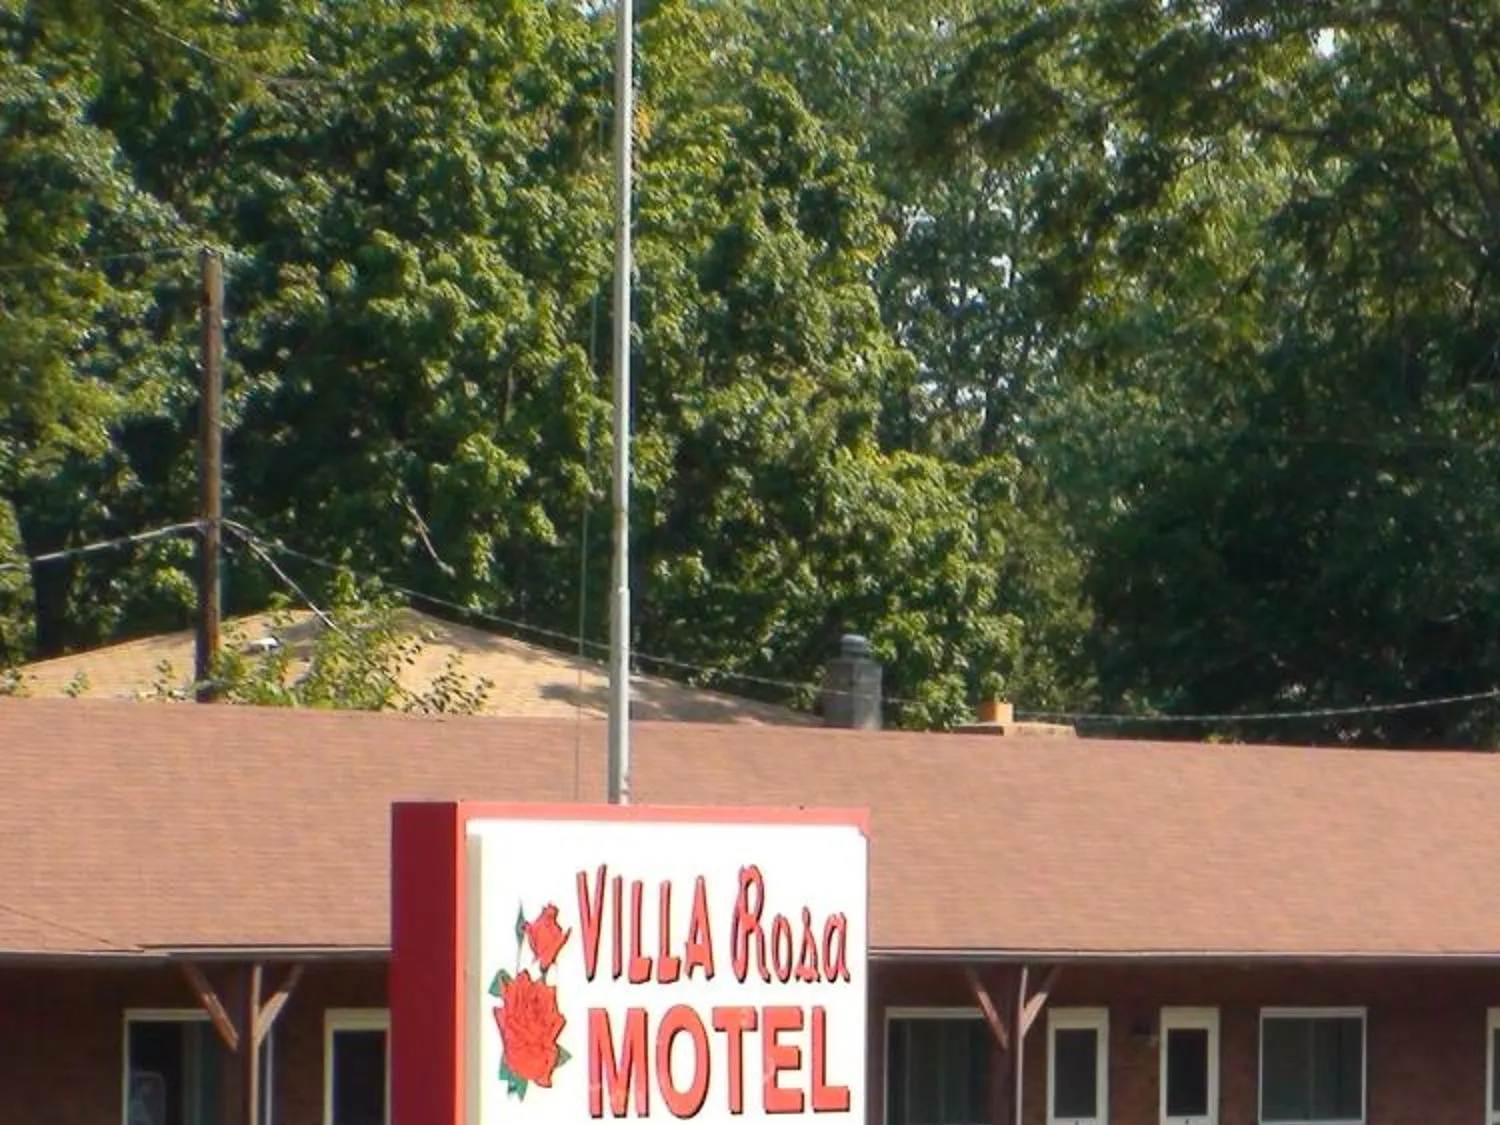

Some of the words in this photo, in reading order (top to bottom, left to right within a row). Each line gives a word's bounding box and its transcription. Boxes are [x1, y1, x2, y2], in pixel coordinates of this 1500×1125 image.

[576, 863, 715, 984] VILLA
[731, 866, 850, 984] Rosa
[589, 1005, 850, 1120] MOTEL
